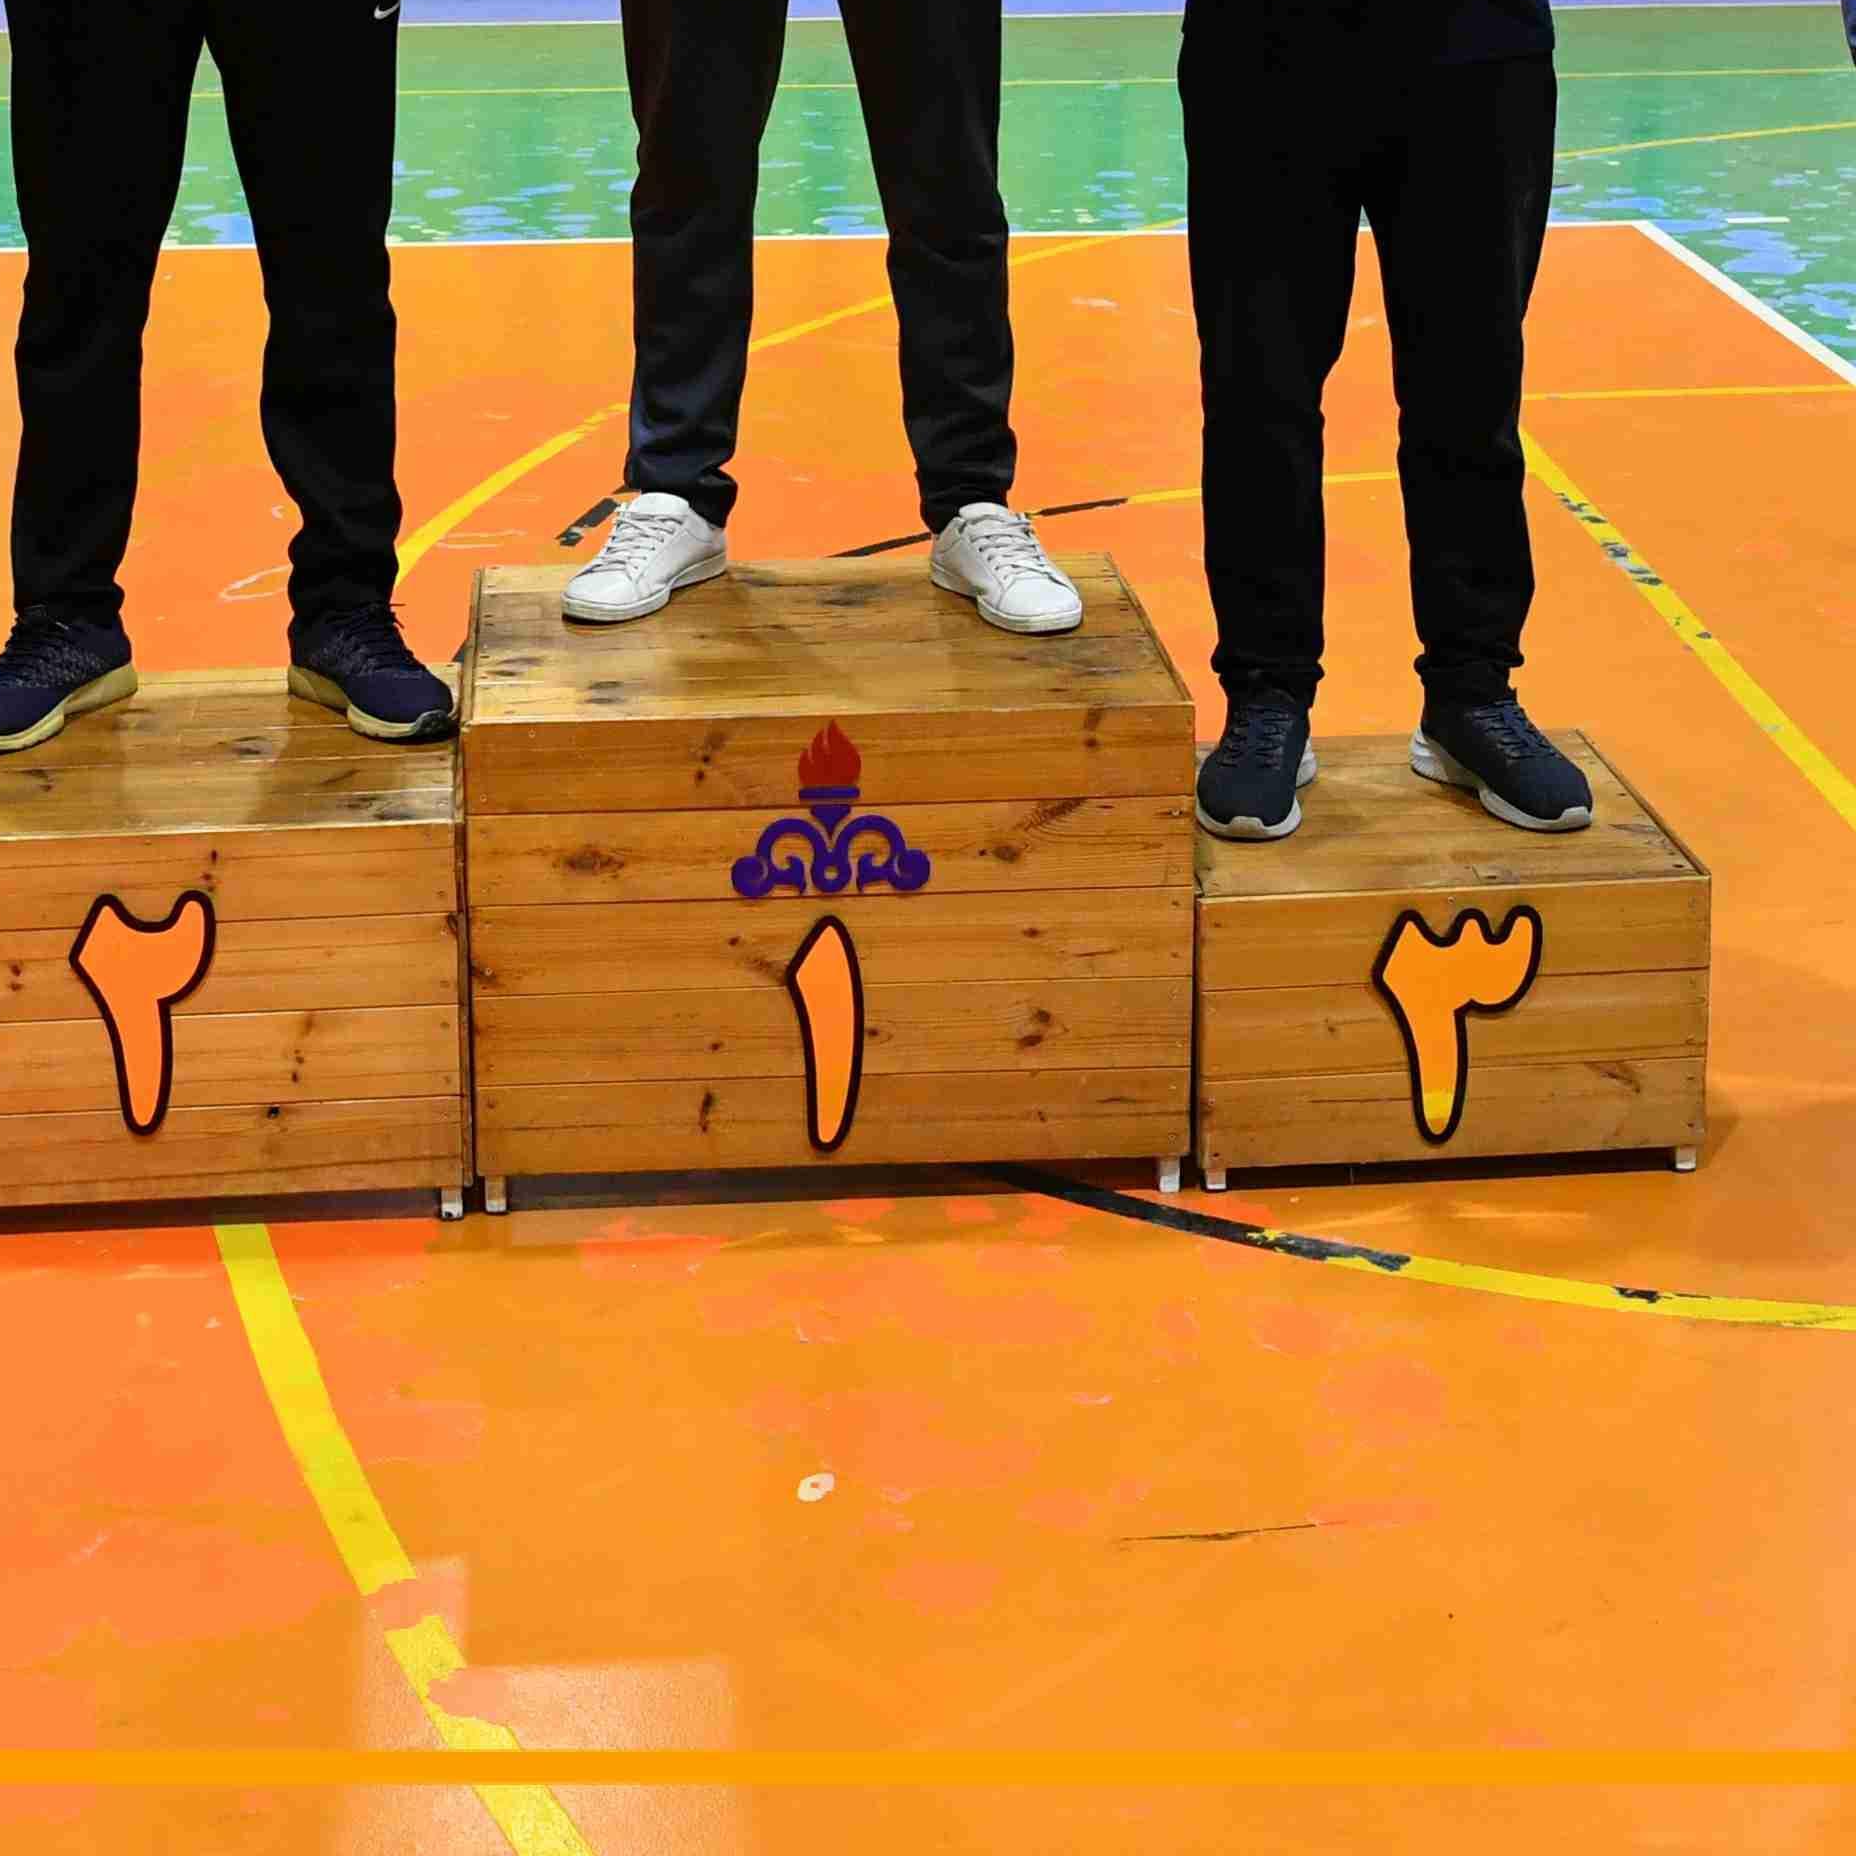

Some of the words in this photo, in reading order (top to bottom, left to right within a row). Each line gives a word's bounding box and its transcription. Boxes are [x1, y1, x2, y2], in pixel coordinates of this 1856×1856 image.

[68, 888, 217, 1136] ۲
[784, 913, 866, 1151] ۱
[1370, 904, 1545, 1145] ۳
